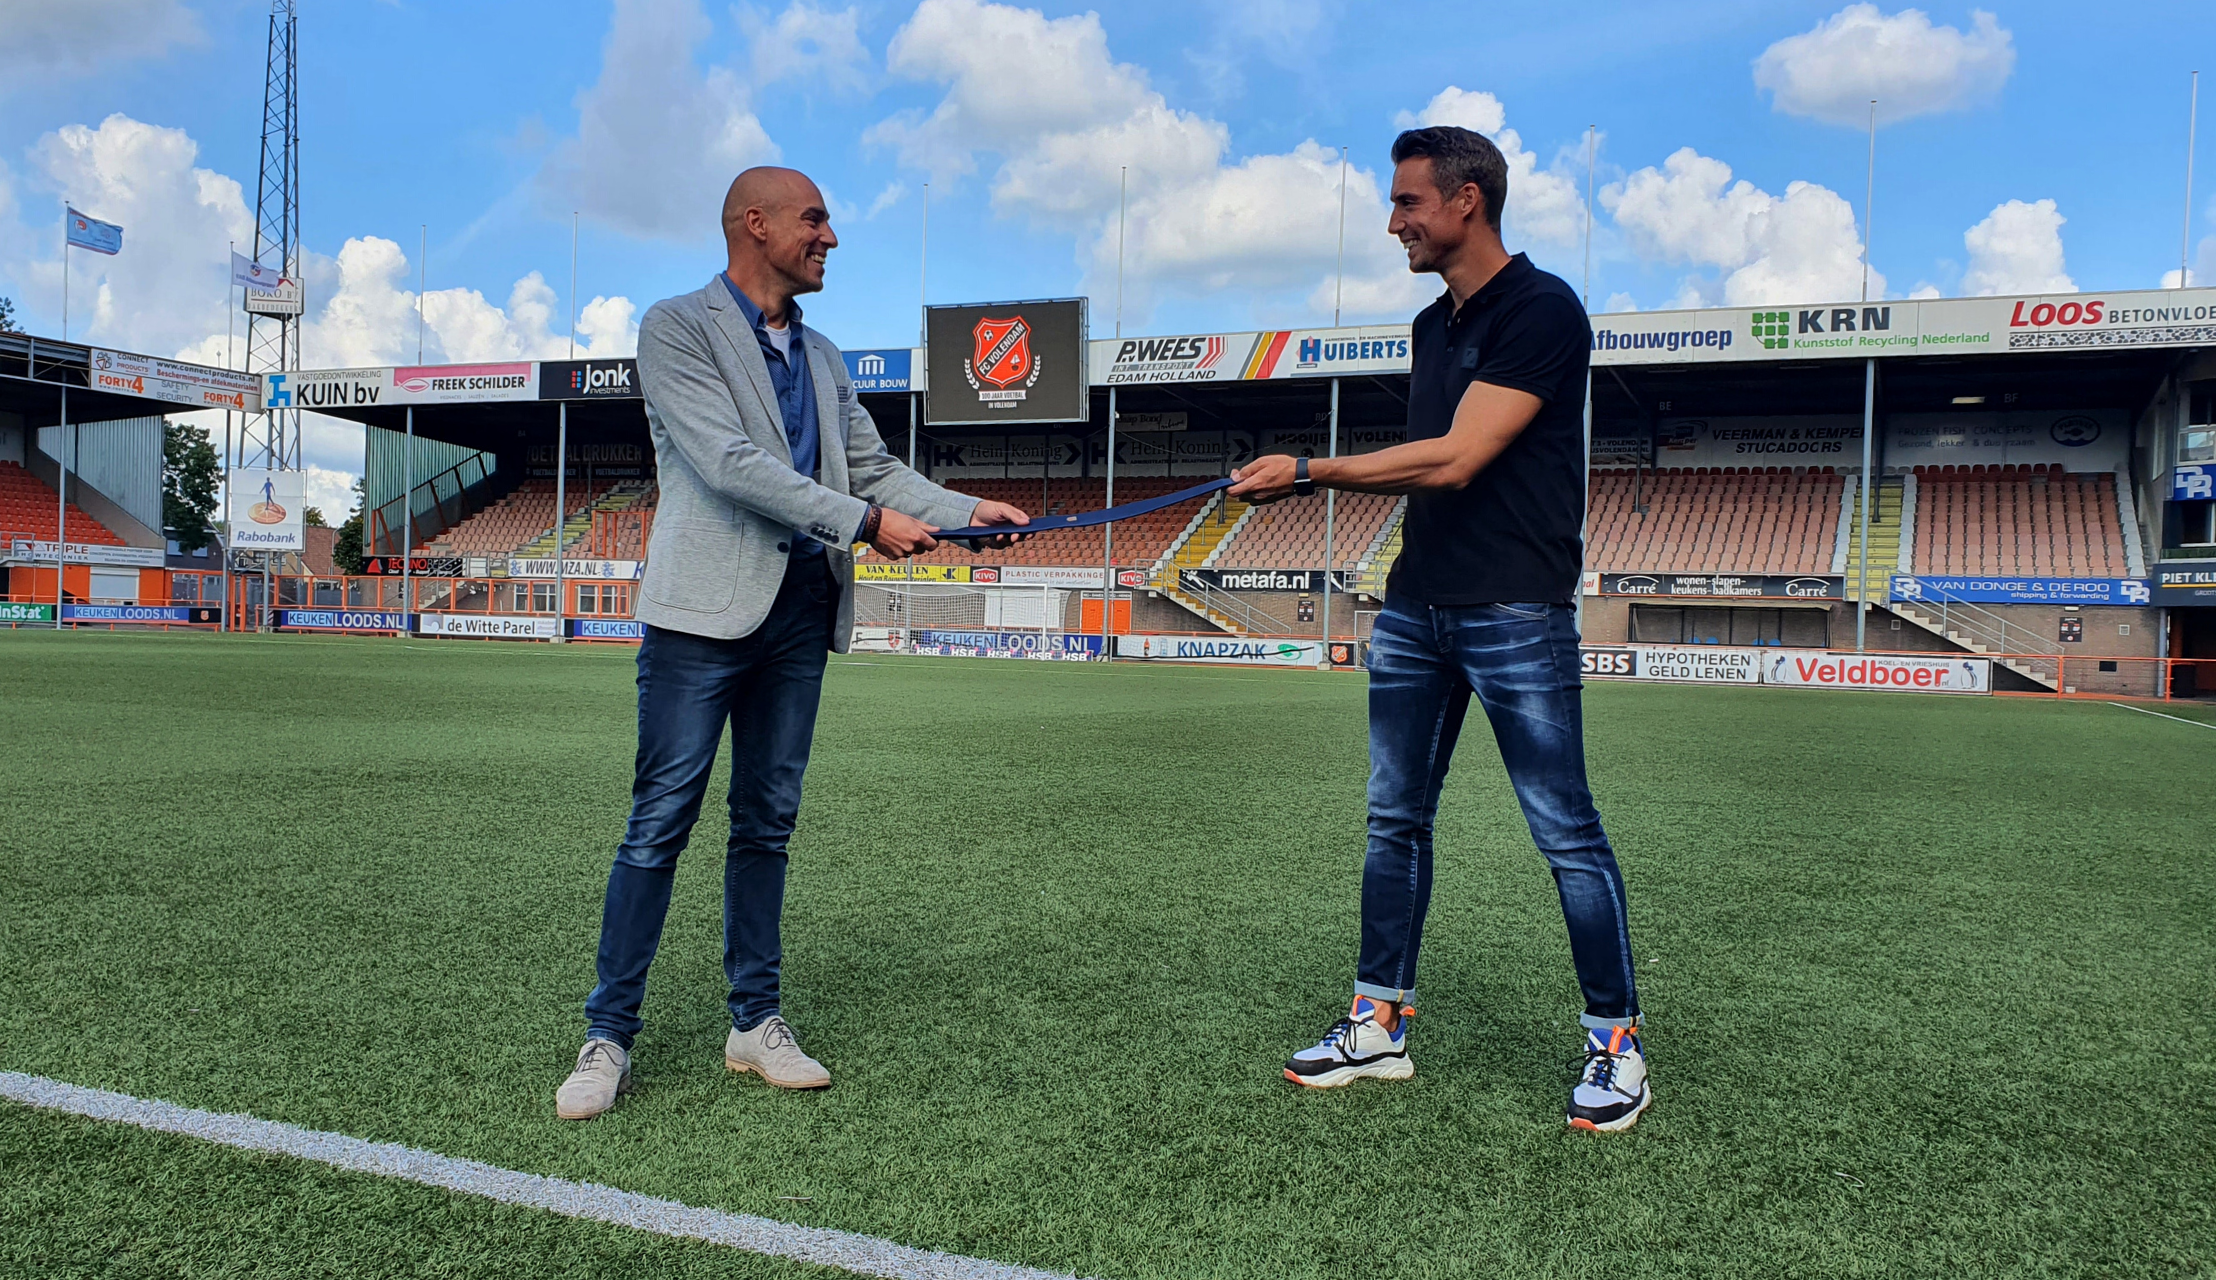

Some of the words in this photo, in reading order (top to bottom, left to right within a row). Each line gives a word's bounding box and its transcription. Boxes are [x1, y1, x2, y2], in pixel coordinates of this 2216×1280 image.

[1799, 307, 1890, 334] KRN
[2010, 301, 2105, 327] LOOS
[1794, 336, 1853, 349] Kunststof
[1859, 335, 1918, 348] Recycling
[1922, 332, 1990, 344] Nederland
[979, 362, 991, 374] FC
[988, 322, 1025, 364] VOLENDAM
[117, 353, 149, 363] CONNECT
[116, 362, 149, 373] PRODUCTS
[156, 361, 255, 383] www.connectproducts.nl
[1137, 362, 1191, 370] TRANSPORT
[297, 370, 382, 381] VASTGOEDONTWIKKELING
[583, 363, 631, 394] jonk
[1107, 373, 1147, 383] EDAM
[1149, 370, 1216, 381] HOLLAND
[161, 380, 189, 391] SAFETY
[210, 378, 258, 392] afdekmaterialen
[432, 378, 466, 390] FREEK
[469, 376, 525, 389] SCHILDER
[880, 379, 908, 389] BOUW
[156, 391, 193, 403] SECURITY
[297, 382, 348, 406] KUIN
[354, 382, 379, 404] bv
[1659, 401, 1672, 411] BE
[1713, 429, 1786, 440] VEERMAN
[1790, 428, 1800, 439] &
[1943, 426, 1966, 435] FISH
[970, 444, 1003, 457] Hein
[1131, 442, 1166, 455] Hein
[237, 530, 296, 544] Rabobank
[866, 566, 884, 574] VAN
[975, 572, 996, 581] KIVO
[1005, 570, 1041, 578] PLASTIC
[1044, 571, 1104, 579] VERPAKKINGE
[1120, 572, 1143, 582] KIVO
[1222, 571, 1309, 589] metafa.nl
[2162, 573, 2192, 583] PIET
[1617, 581, 1657, 594] Carré
[1671, 584, 1762, 596] keukens-badkamers
[1785, 584, 1828, 597] Carré
[1932, 580, 1965, 591] VAN
[1970, 581, 2027, 592] DONGE
[2032, 582, 2045, 592] &
[2011, 591, 2048, 600] shipping
[2050, 591, 2058, 599] &
[2060, 592, 2110, 601] forwarding
[76, 607, 179, 620] KEUKENLOODS.NL
[289, 612, 404, 628] KEUKENLOODS.NL
[448, 618, 462, 632] de
[465, 620, 500, 634] Witte
[503, 621, 535, 634] Parel
[917, 647, 940, 656] HSB
[951, 648, 976, 656] HSB
[987, 650, 1011, 659] HSB
[1063, 652, 1087, 661] HSB
[1177, 641, 1266, 659] KNAPZAK
[1581, 653, 1630, 674] SBS
[1646, 652, 1750, 666] HYPOTHEKEN
[1649, 666, 1690, 678] GELD
[1695, 667, 1746, 679] LENEN
[1796, 658, 1950, 687] Veldboer
